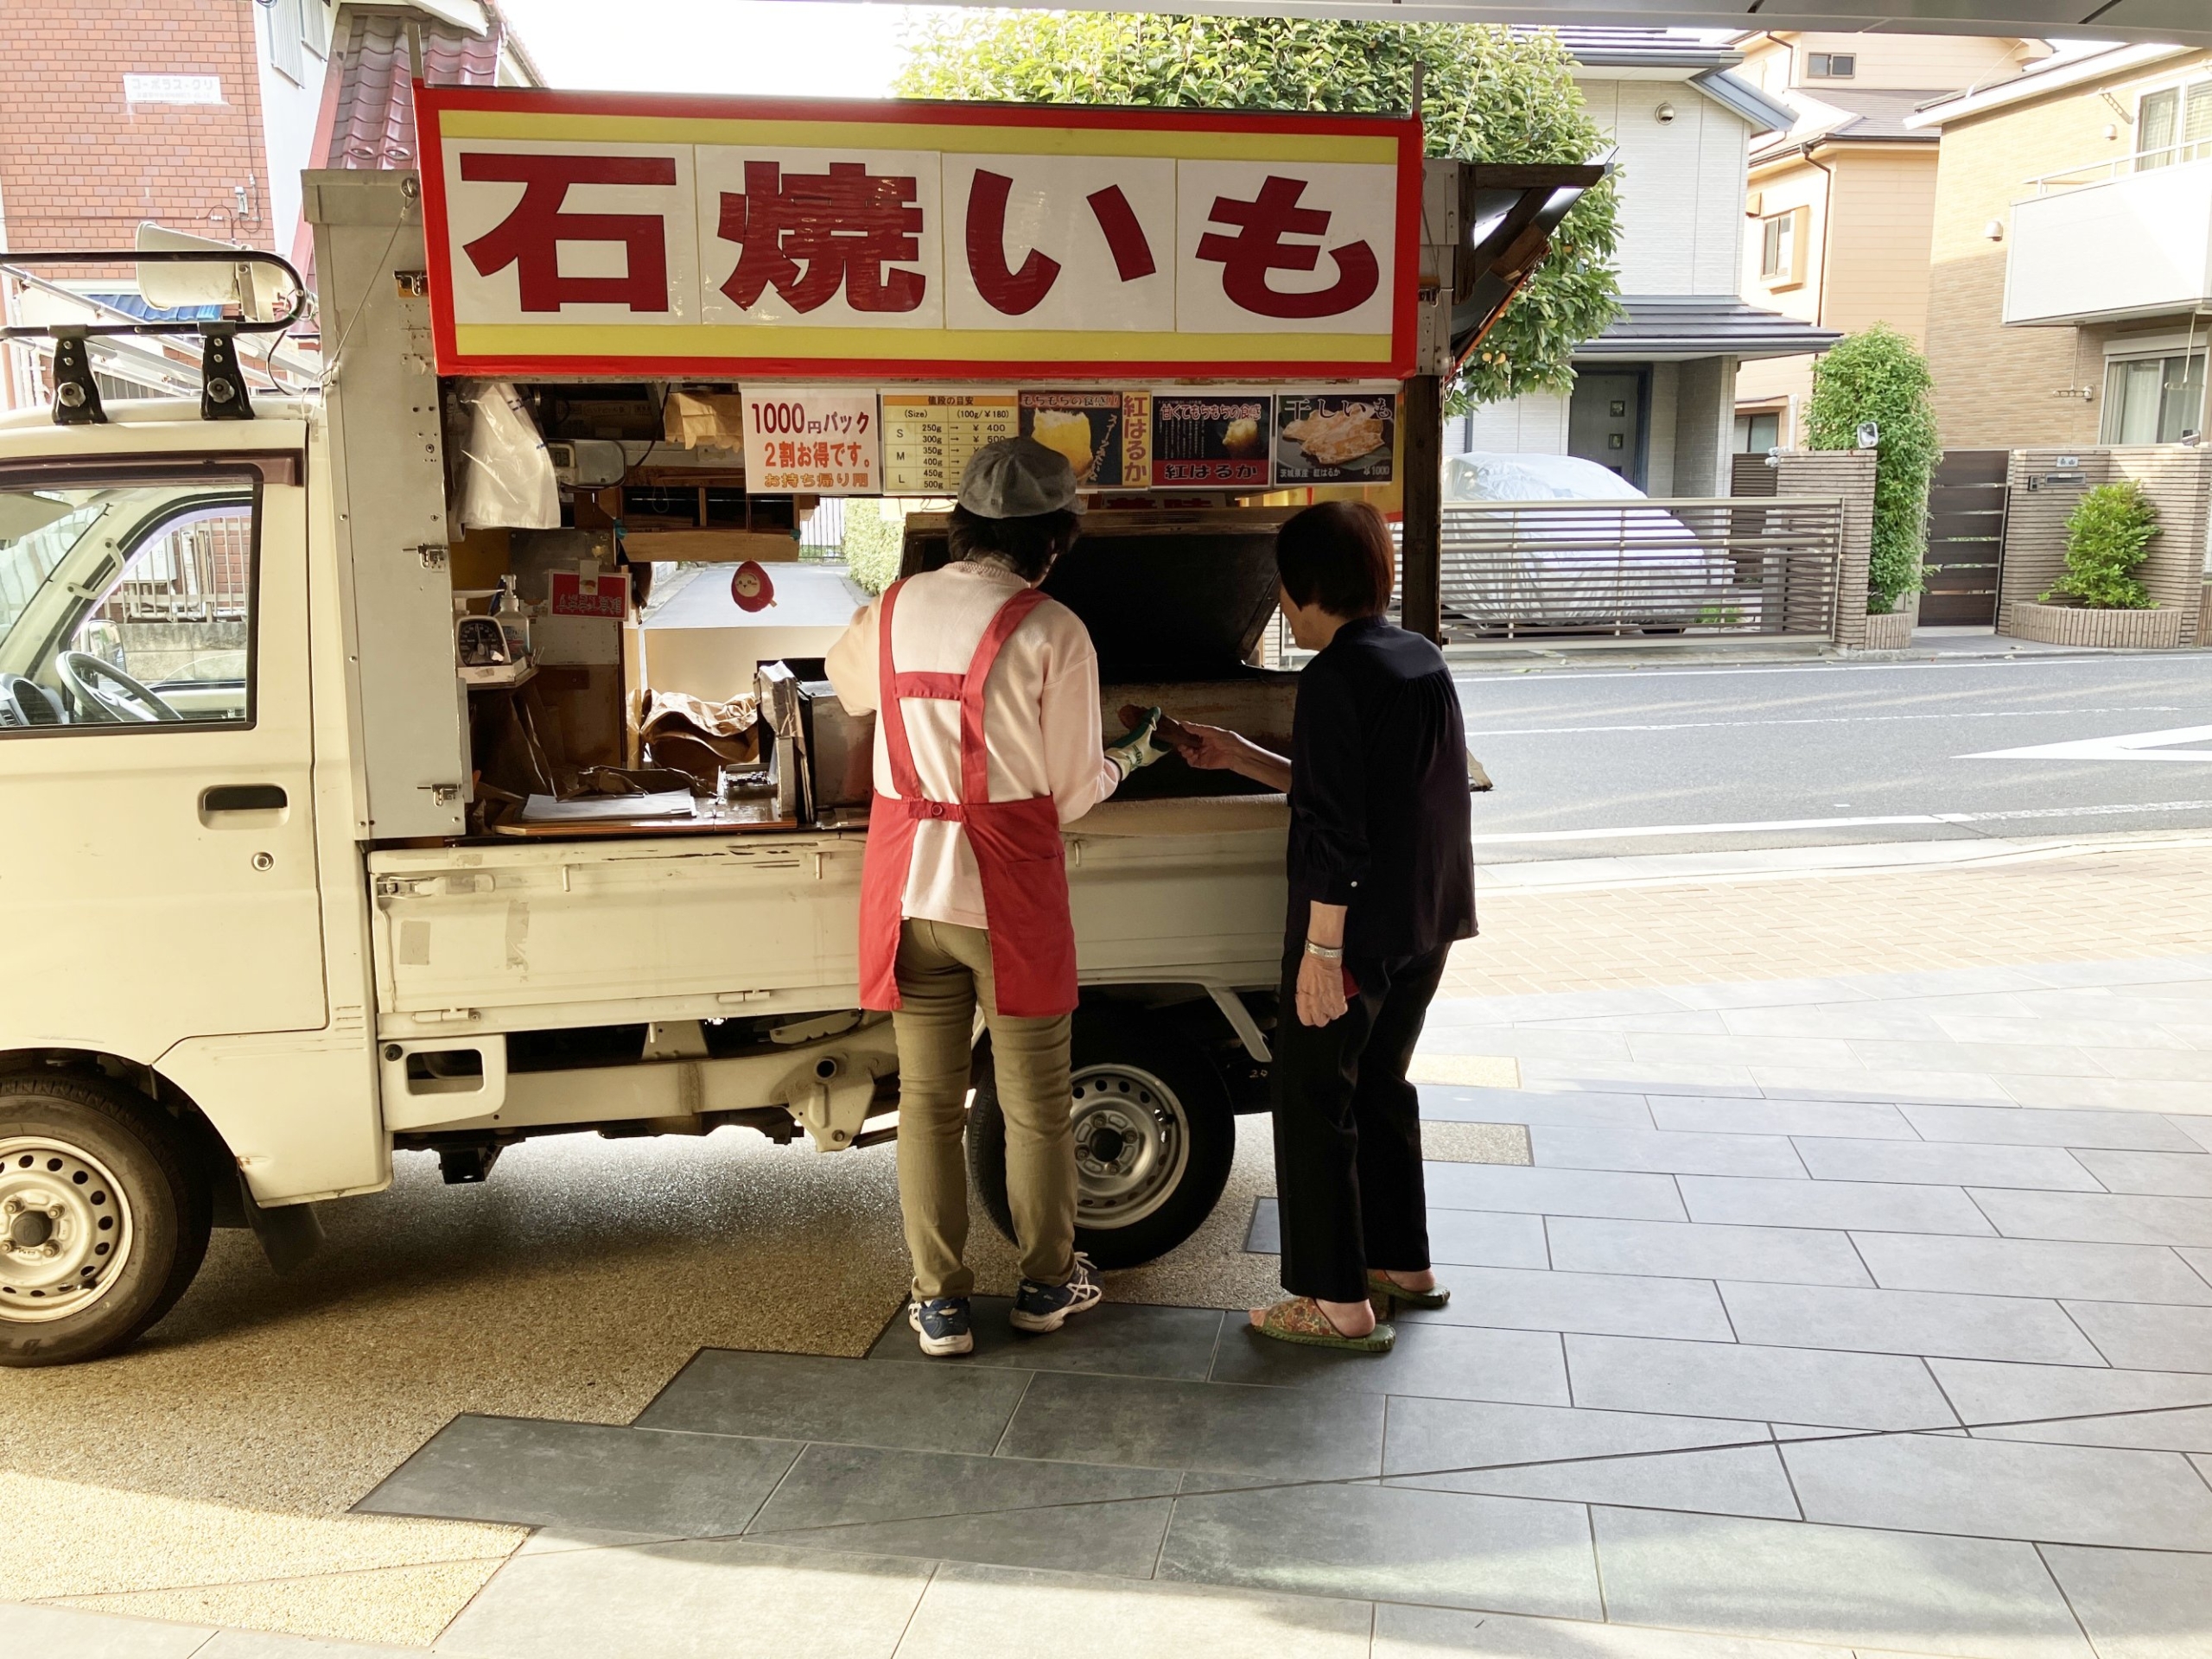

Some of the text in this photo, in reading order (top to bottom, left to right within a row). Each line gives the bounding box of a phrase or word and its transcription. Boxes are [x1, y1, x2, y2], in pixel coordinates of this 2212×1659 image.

[460, 153, 1379, 319] 石焼いも
[928, 396, 974, 406] 値段の目安
[904, 410, 928, 418] (Size)
[1161, 404, 1262, 420] 甘くてもちもちの食感
[1285, 397, 1393, 422] 干しいも
[922, 424, 942, 433] 250g
[897, 429, 904, 438] S
[922, 435, 942, 444] 300g
[1123, 396, 1147, 482] 紅はるか
[765, 441, 869, 468] 2割お得です。
[923, 447, 943, 455] 350g
[896, 452, 905, 461] M
[923, 458, 943, 467] 400g
[923, 469, 943, 478] 450g
[1165, 464, 1257, 480] 紅はるか
[1313, 468, 1340, 477] 紅はるか
[765, 473, 868, 488] お持ち帰り用
[899, 475, 906, 484] L
[924, 480, 944, 489] 500g
